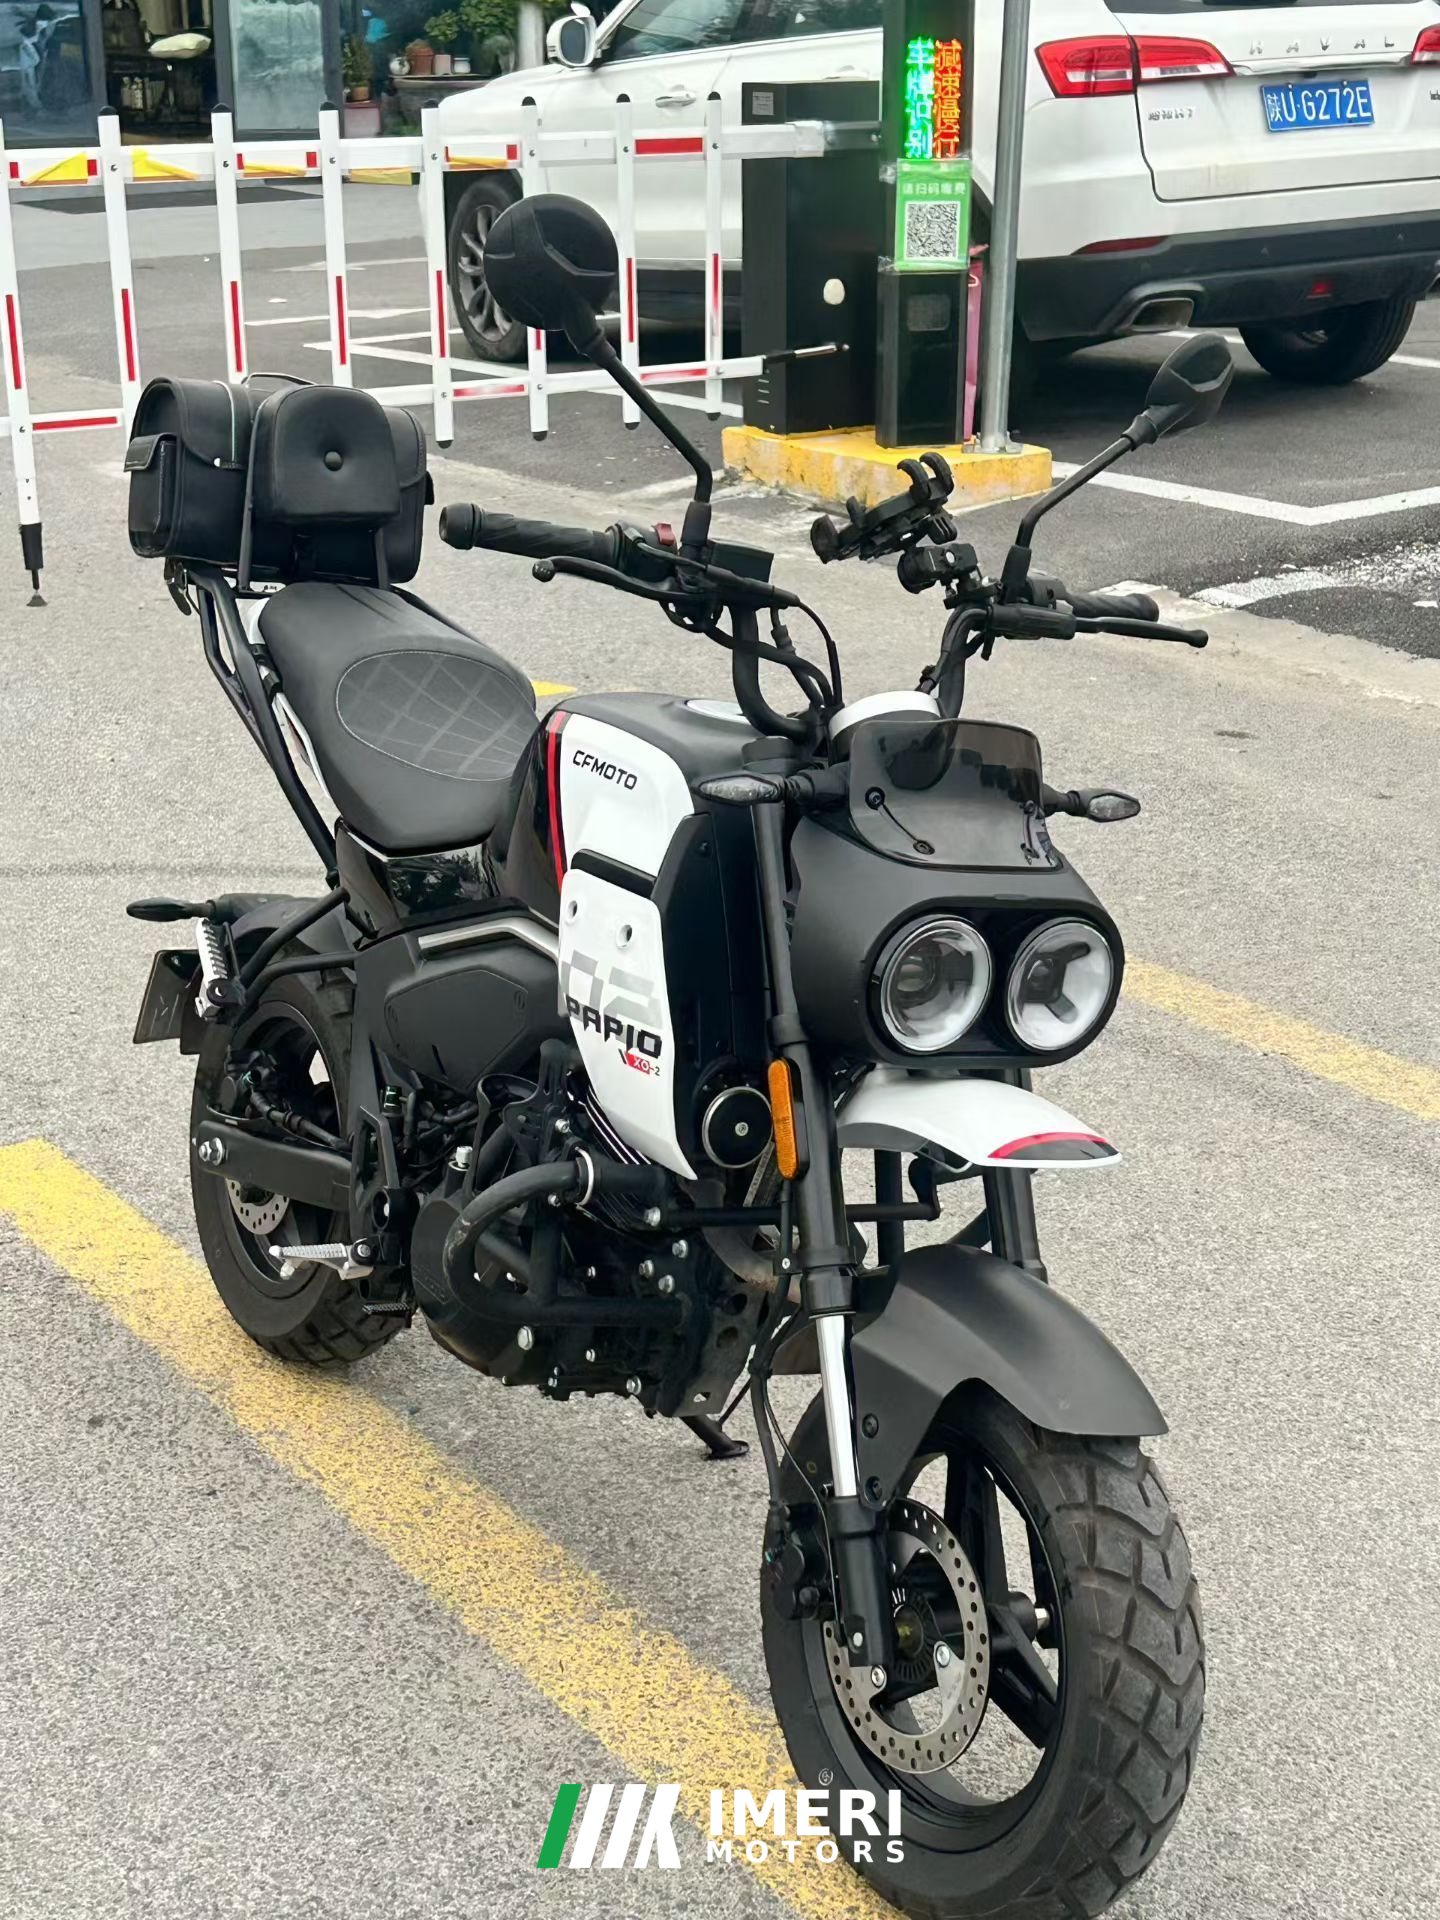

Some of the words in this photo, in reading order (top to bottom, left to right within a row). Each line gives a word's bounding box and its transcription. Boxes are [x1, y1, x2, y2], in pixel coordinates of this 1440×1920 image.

[572, 749, 638, 790] CFMOTO
[565, 993, 662, 1059] PAPIO
[634, 1056, 660, 1077] XO-2
